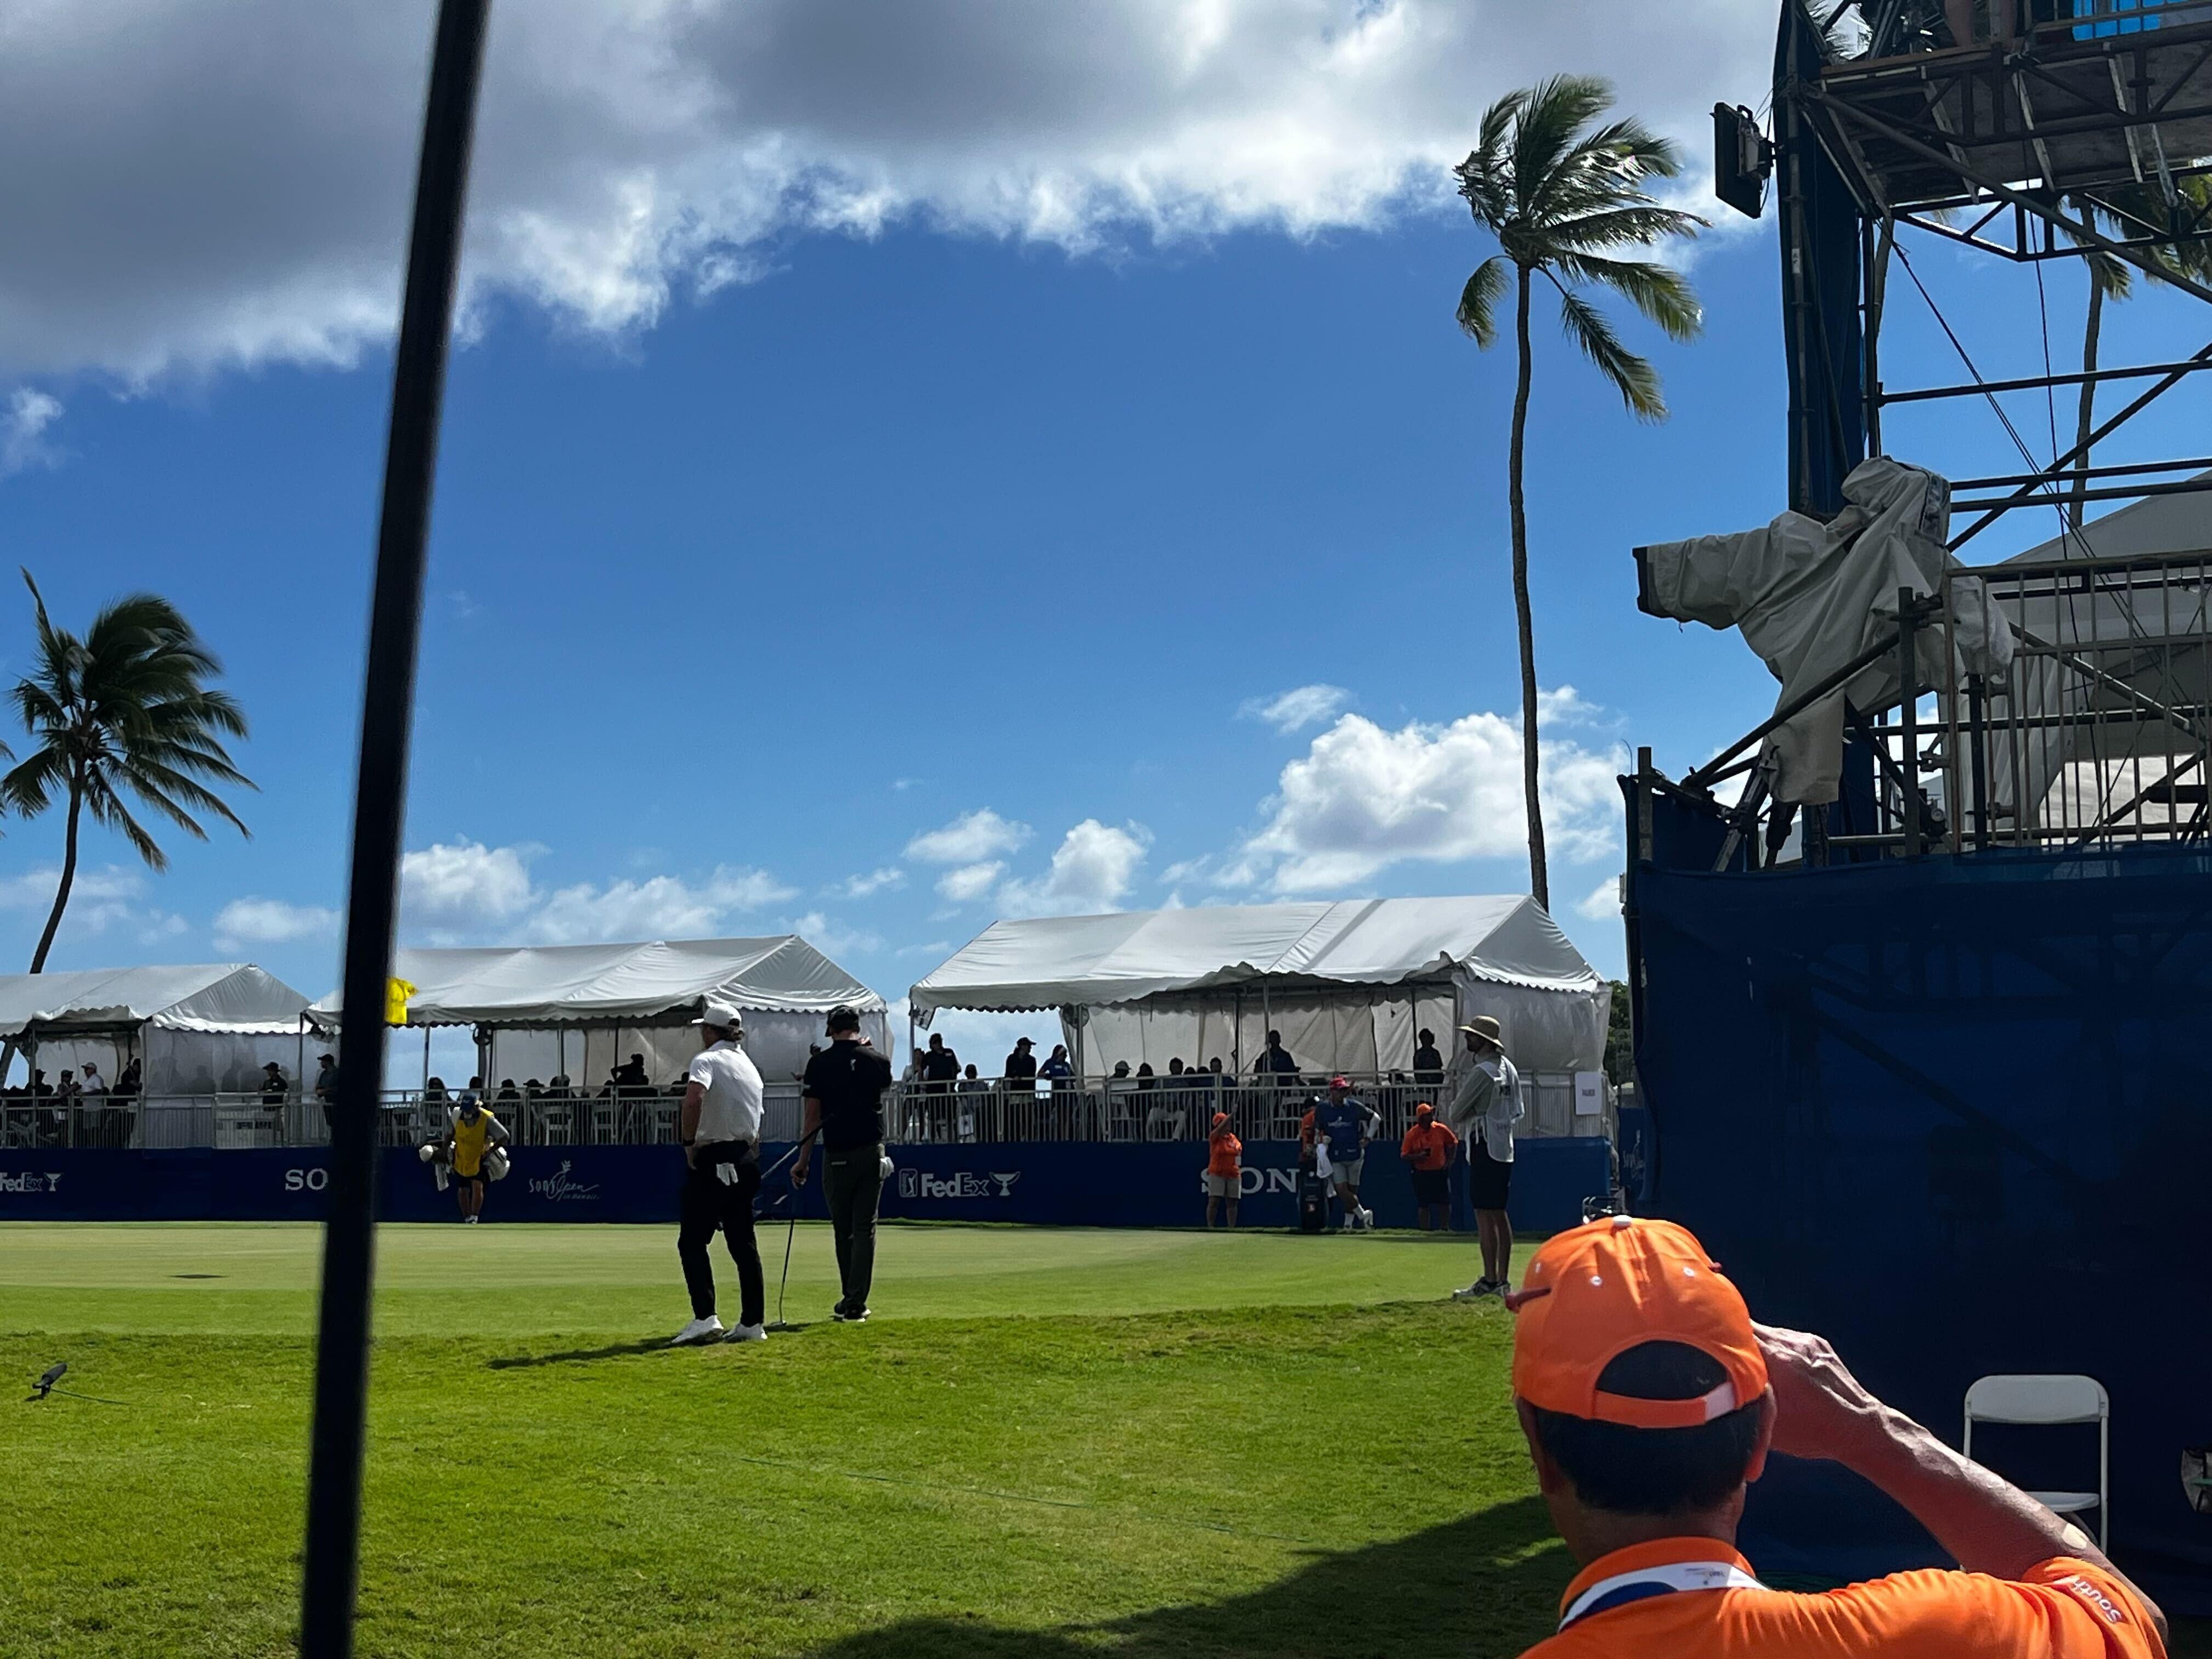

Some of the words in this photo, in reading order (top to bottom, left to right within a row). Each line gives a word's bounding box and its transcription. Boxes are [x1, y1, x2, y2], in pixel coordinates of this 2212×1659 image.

[0, 1172, 43, 1192] FedEx
[285, 1168, 329, 1191] SO
[922, 1172, 989, 1197] FedEx
